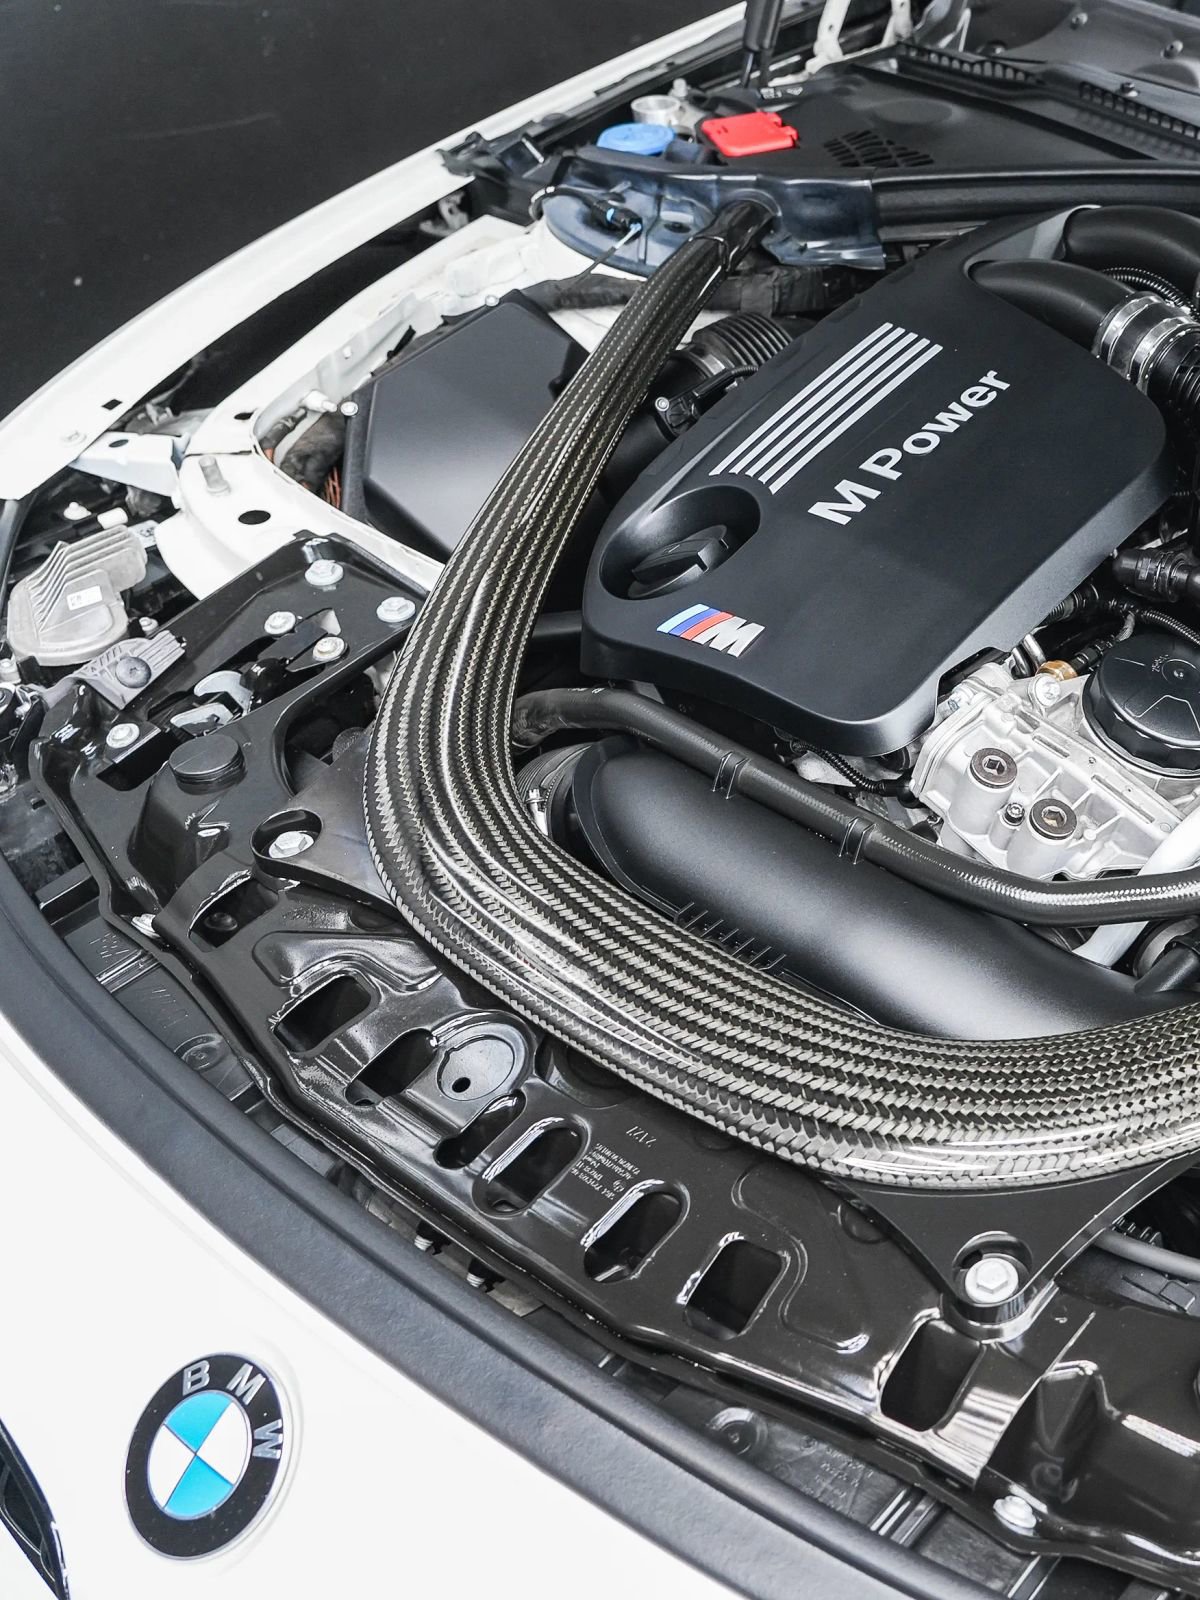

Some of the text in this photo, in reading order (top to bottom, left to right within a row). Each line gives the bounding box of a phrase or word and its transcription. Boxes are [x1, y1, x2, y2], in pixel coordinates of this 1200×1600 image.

[807, 370, 1011, 525] M Power
[688, 613, 765, 658] M
[182, 1359, 284, 1460] BMW
